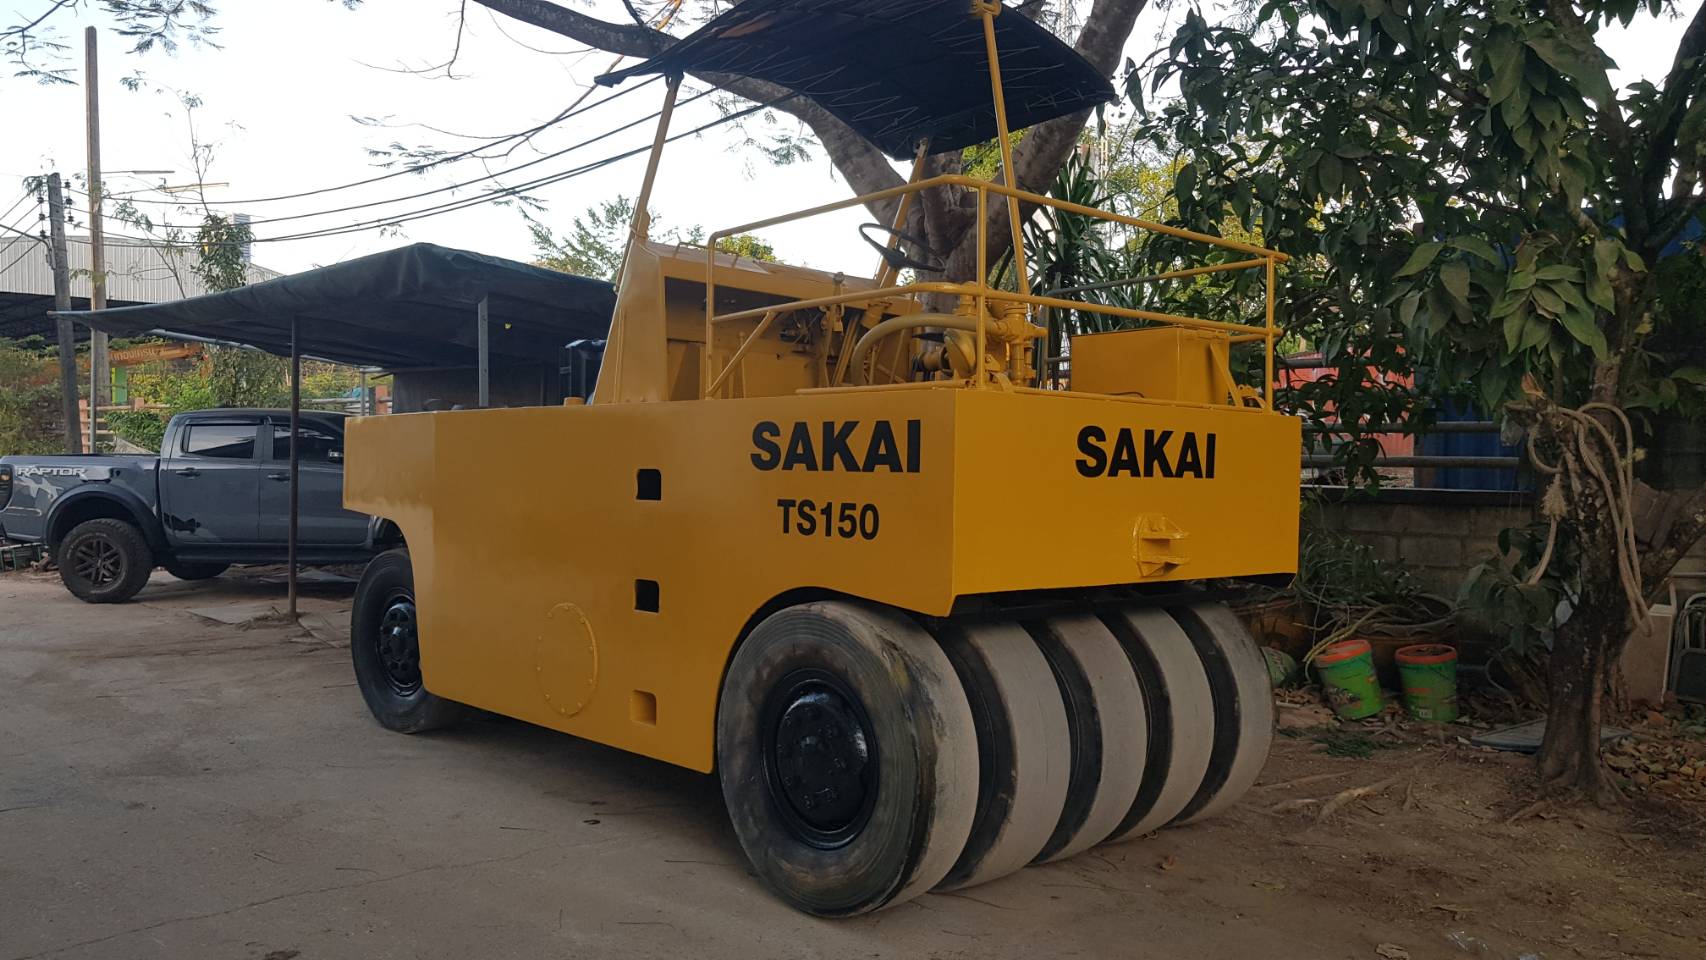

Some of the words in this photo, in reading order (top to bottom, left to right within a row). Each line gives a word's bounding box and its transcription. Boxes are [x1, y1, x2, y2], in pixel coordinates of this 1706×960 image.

[751, 419, 921, 473] SAKAI
[1076, 425, 1217, 479] SAKAI
[17, 467, 87, 477] RAPTOR
[777, 499, 879, 541] TS150
